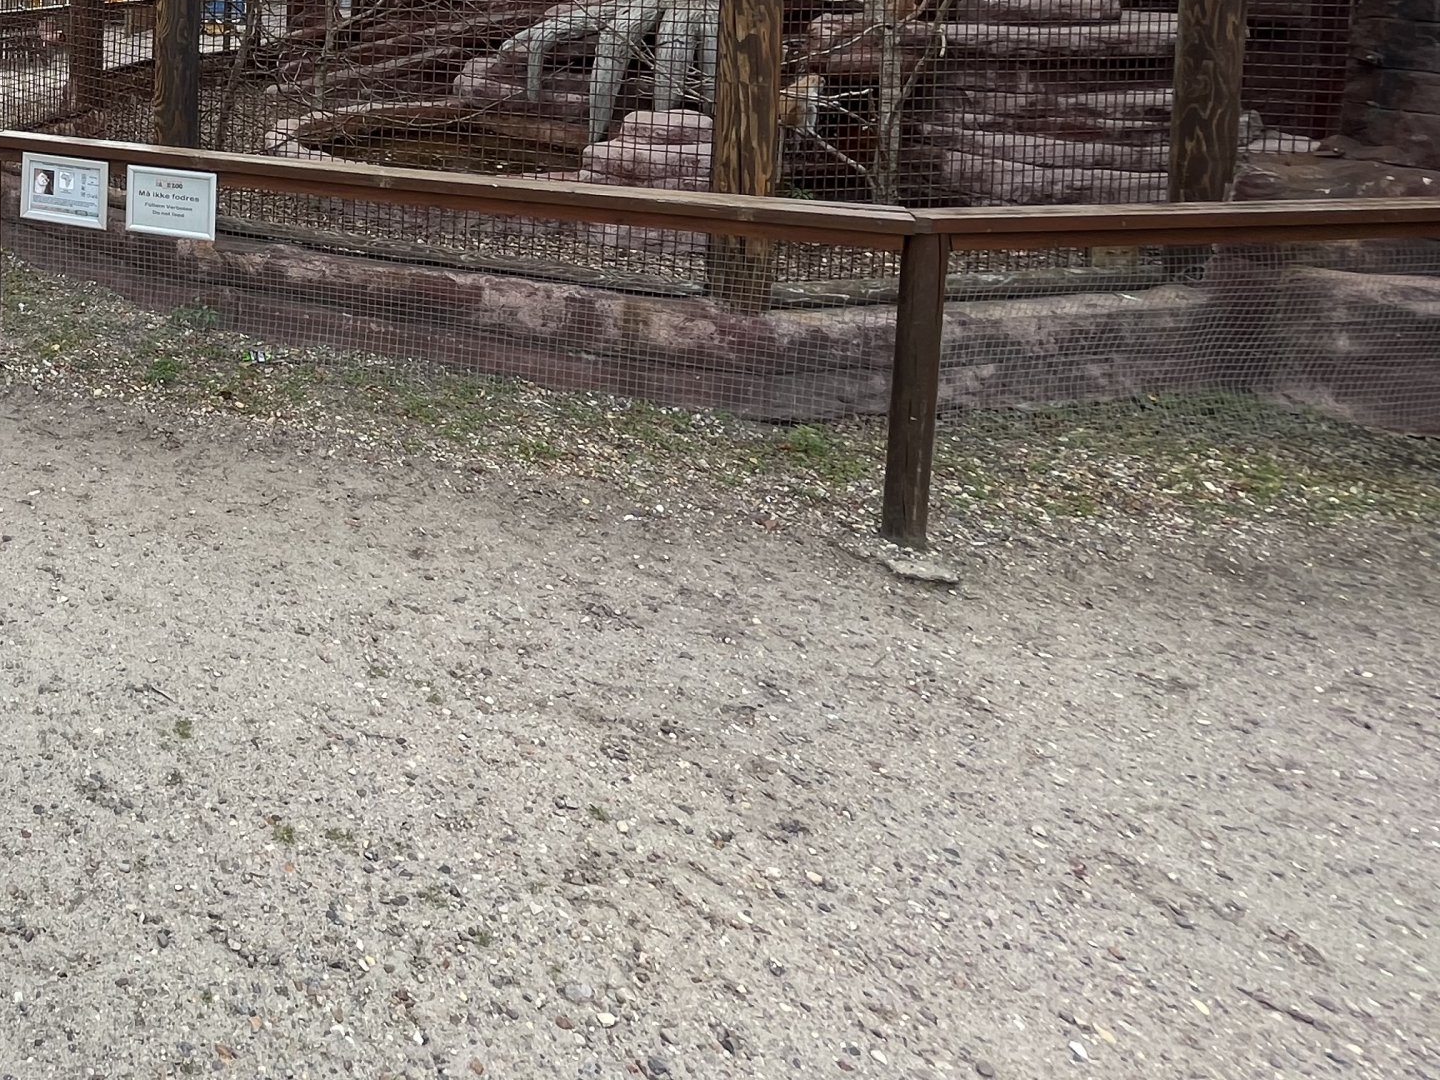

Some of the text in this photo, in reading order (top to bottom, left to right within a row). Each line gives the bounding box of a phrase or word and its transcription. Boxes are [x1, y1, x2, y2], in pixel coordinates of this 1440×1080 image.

[138, 189, 200, 203] Må ikke fodres
